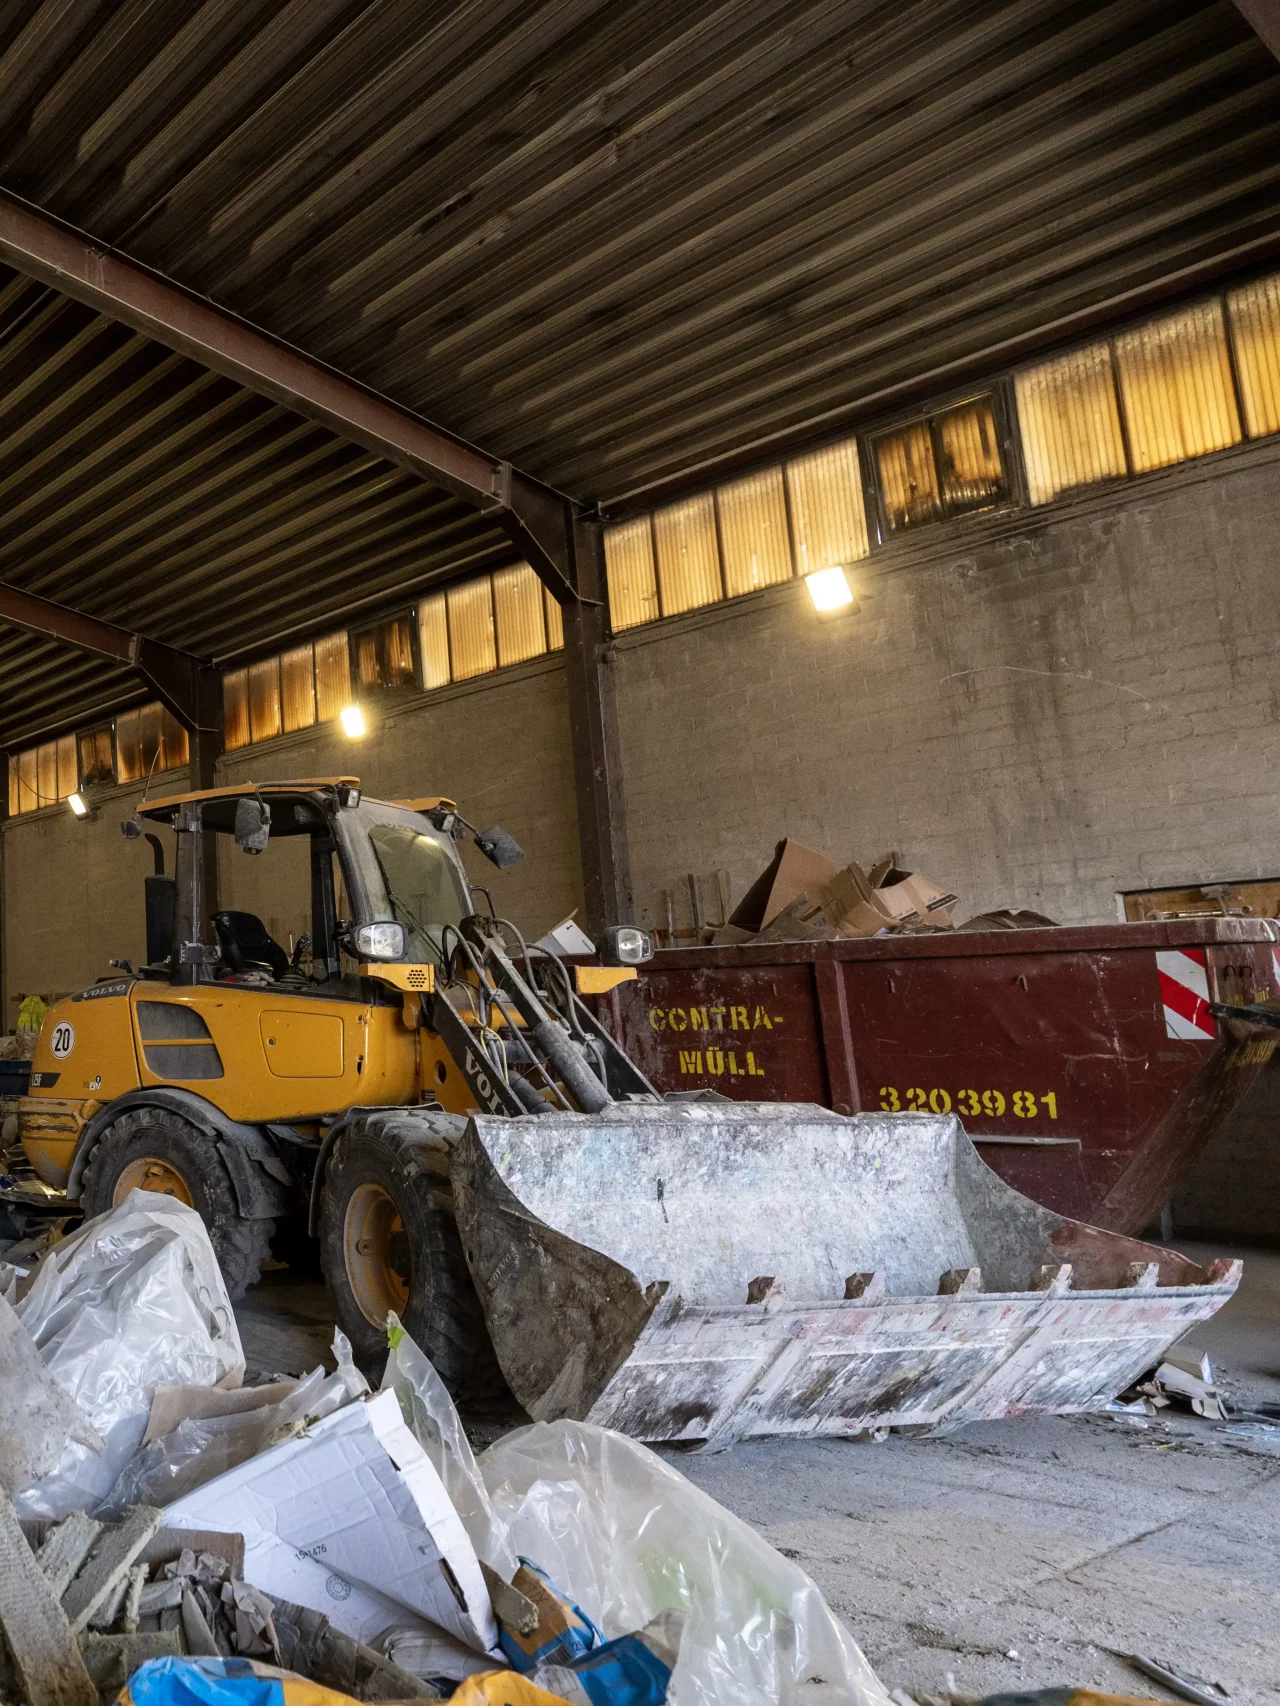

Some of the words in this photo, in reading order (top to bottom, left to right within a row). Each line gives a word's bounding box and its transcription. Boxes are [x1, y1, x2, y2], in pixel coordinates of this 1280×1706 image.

[82, 984, 126, 998] VOLVO
[649, 1005, 784, 1031] CONTRA-
[54, 1028, 70, 1052] 20
[679, 1046, 765, 1076] MÜLL
[465, 1046, 511, 1117] VOL
[879, 1086, 1058, 1119] 3203981
